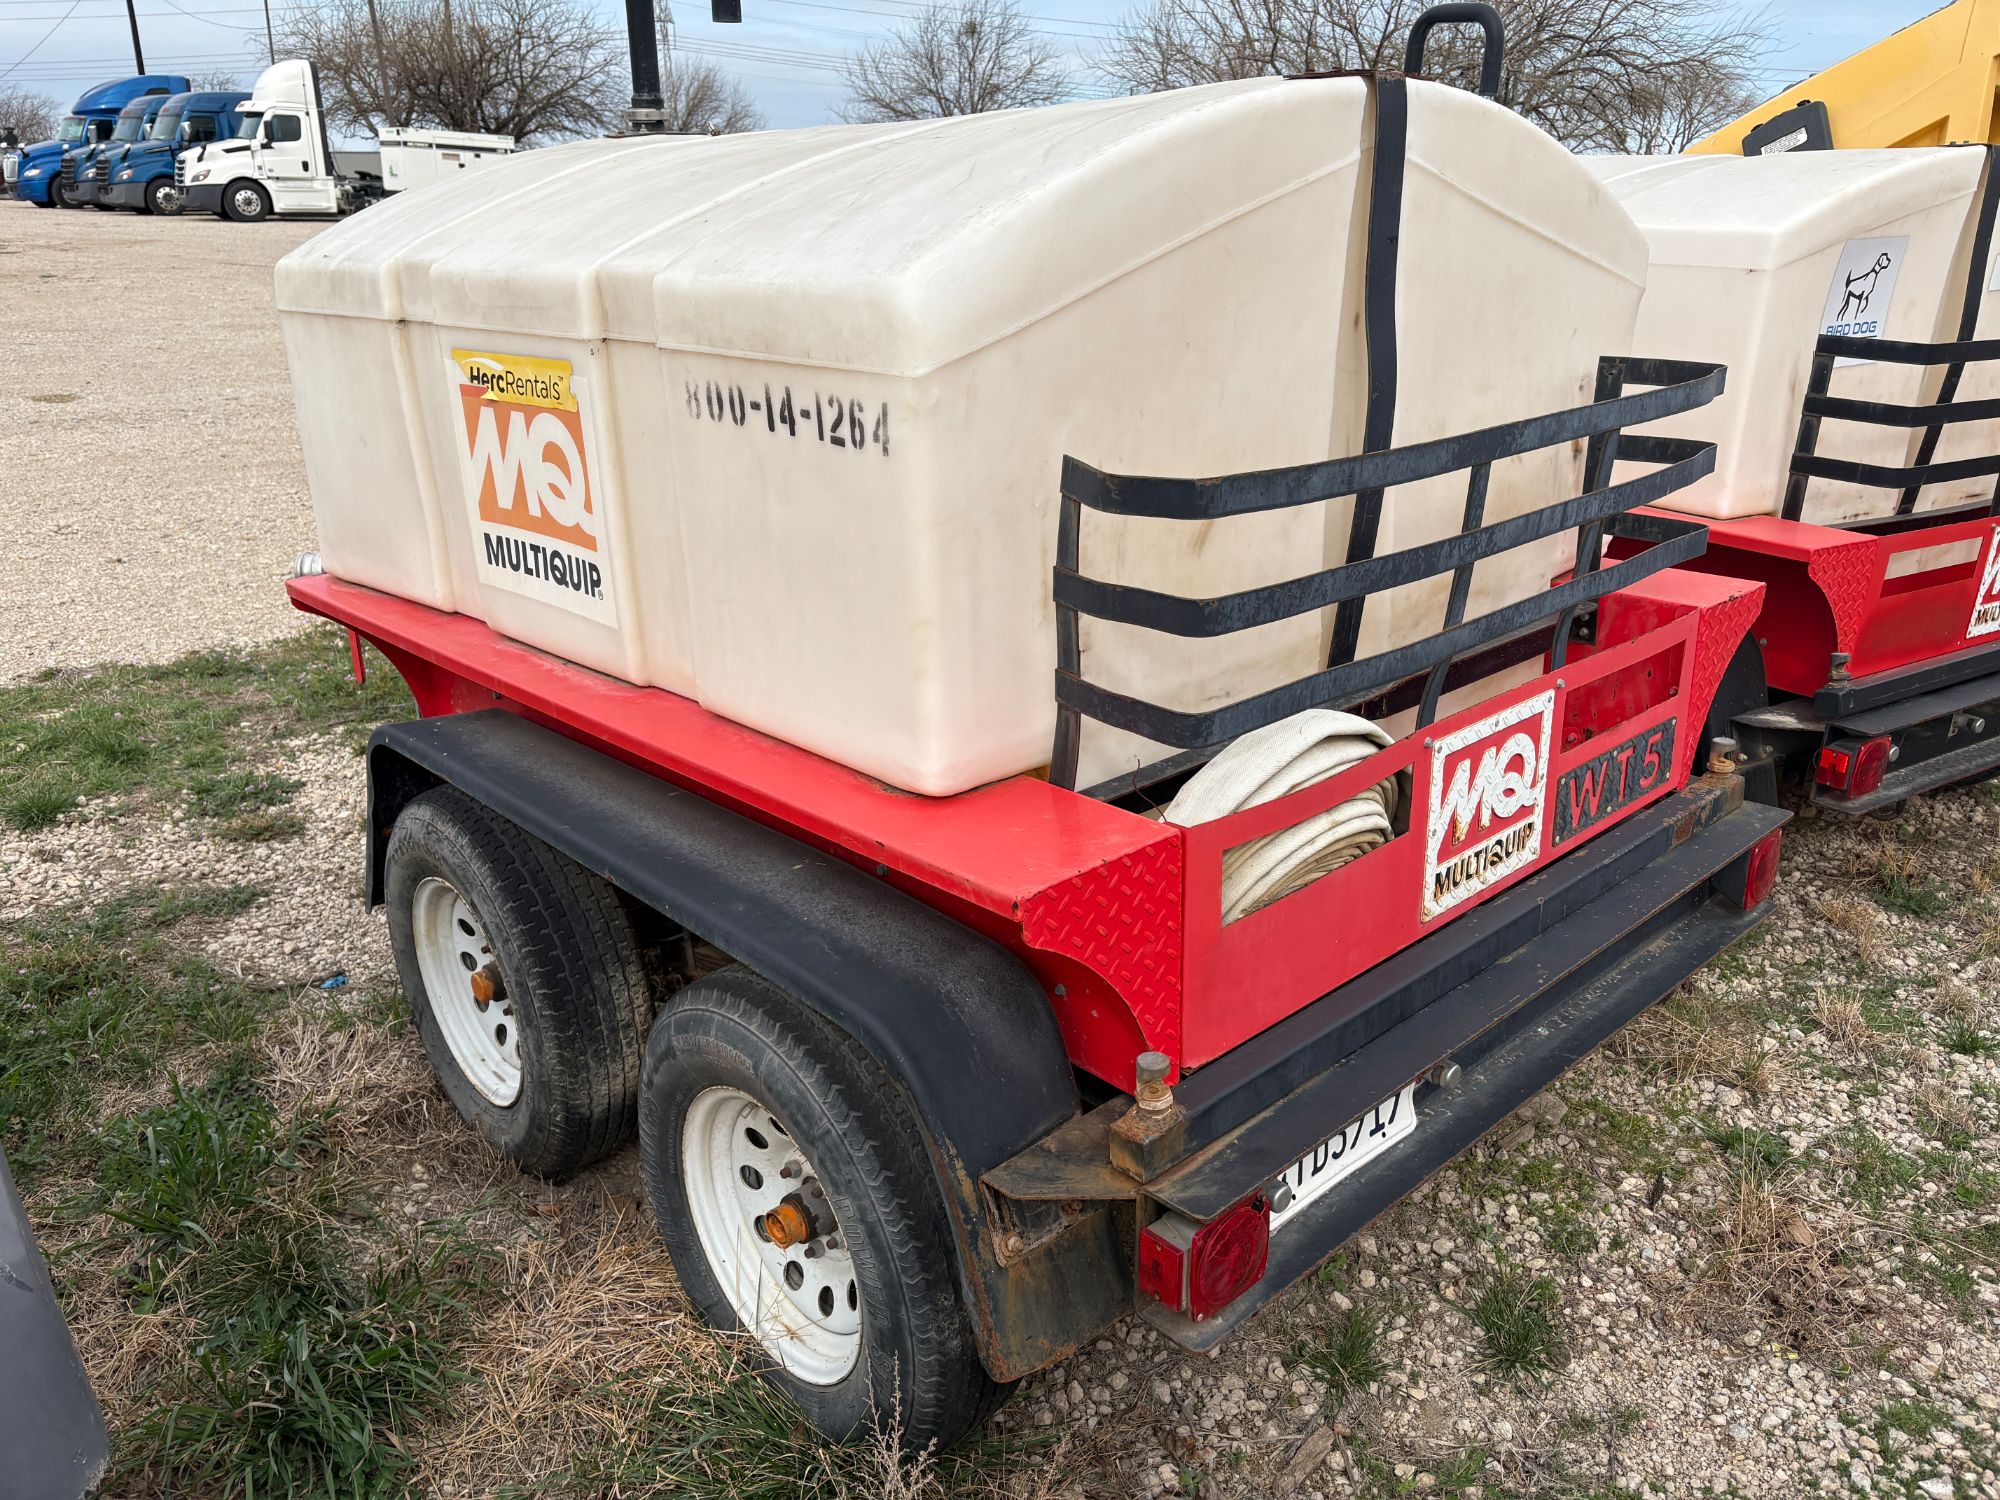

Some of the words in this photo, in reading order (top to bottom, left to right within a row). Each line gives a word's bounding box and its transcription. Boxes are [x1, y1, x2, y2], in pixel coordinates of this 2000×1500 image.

[1826, 323, 1851, 336] BIRD
[1852, 320, 1878, 335] DOG
[684, 379, 890, 457] 800-14-1264
[467, 405, 597, 537] MQ
[1440, 732, 1547, 846] MQ
[1433, 821, 1535, 899] MULTIQUIP
